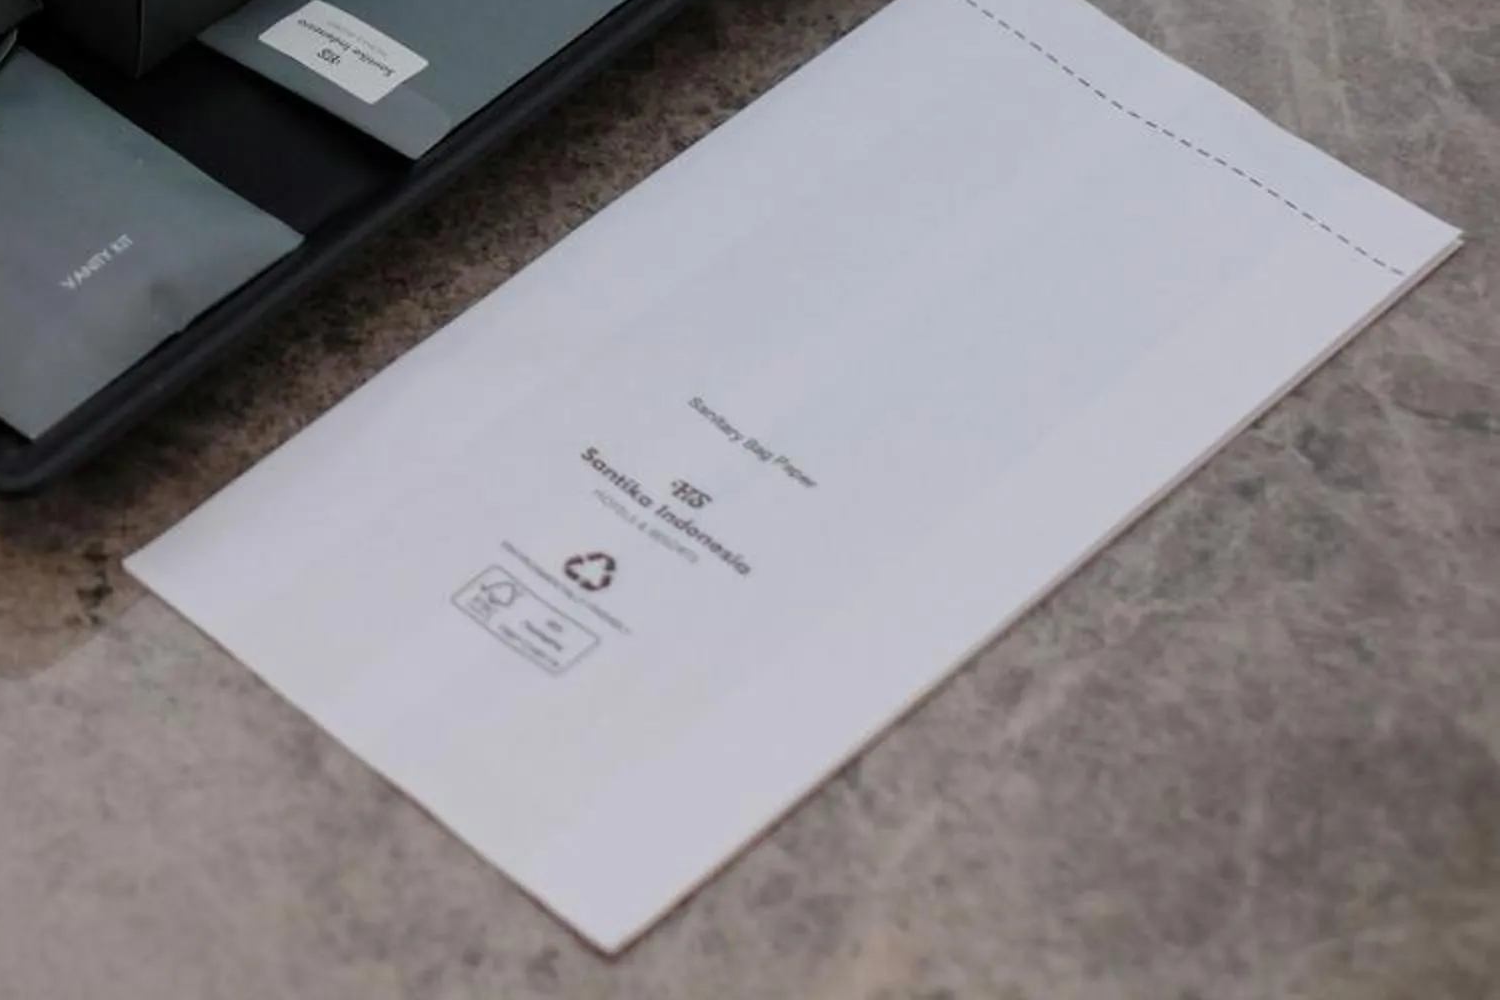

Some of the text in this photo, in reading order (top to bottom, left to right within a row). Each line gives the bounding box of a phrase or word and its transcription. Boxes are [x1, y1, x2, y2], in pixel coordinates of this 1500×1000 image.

[60, 233, 133, 290] VANITY KIT
[687, 396, 819, 488] Sanitary Bag Paper
[580, 446, 751, 577] Santika Indonesia
